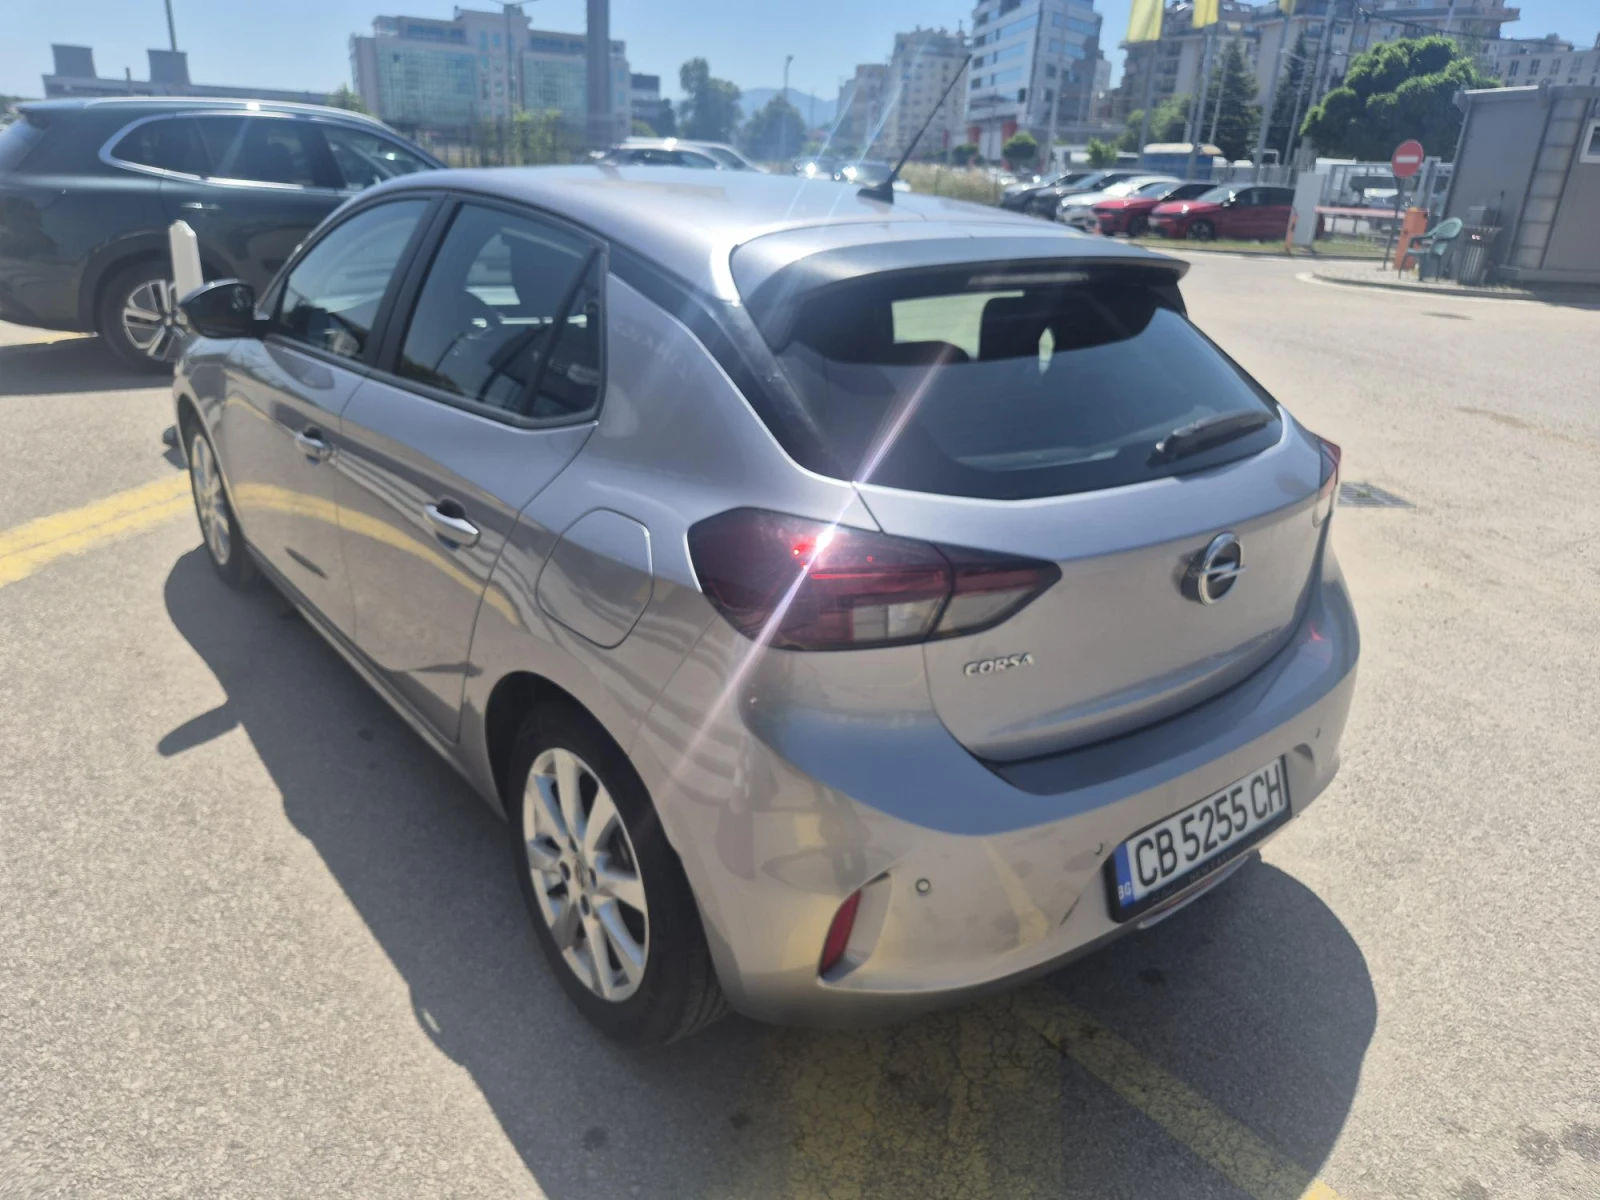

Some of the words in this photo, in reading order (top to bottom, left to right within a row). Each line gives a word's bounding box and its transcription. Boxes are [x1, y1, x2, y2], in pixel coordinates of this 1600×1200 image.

[963, 652, 1034, 677] CORSA
[1135, 828, 1177, 887] CB
[1180, 785, 1247, 862] 5255
[1250, 763, 1283, 820] CH
[1117, 881, 1132, 900] BG
